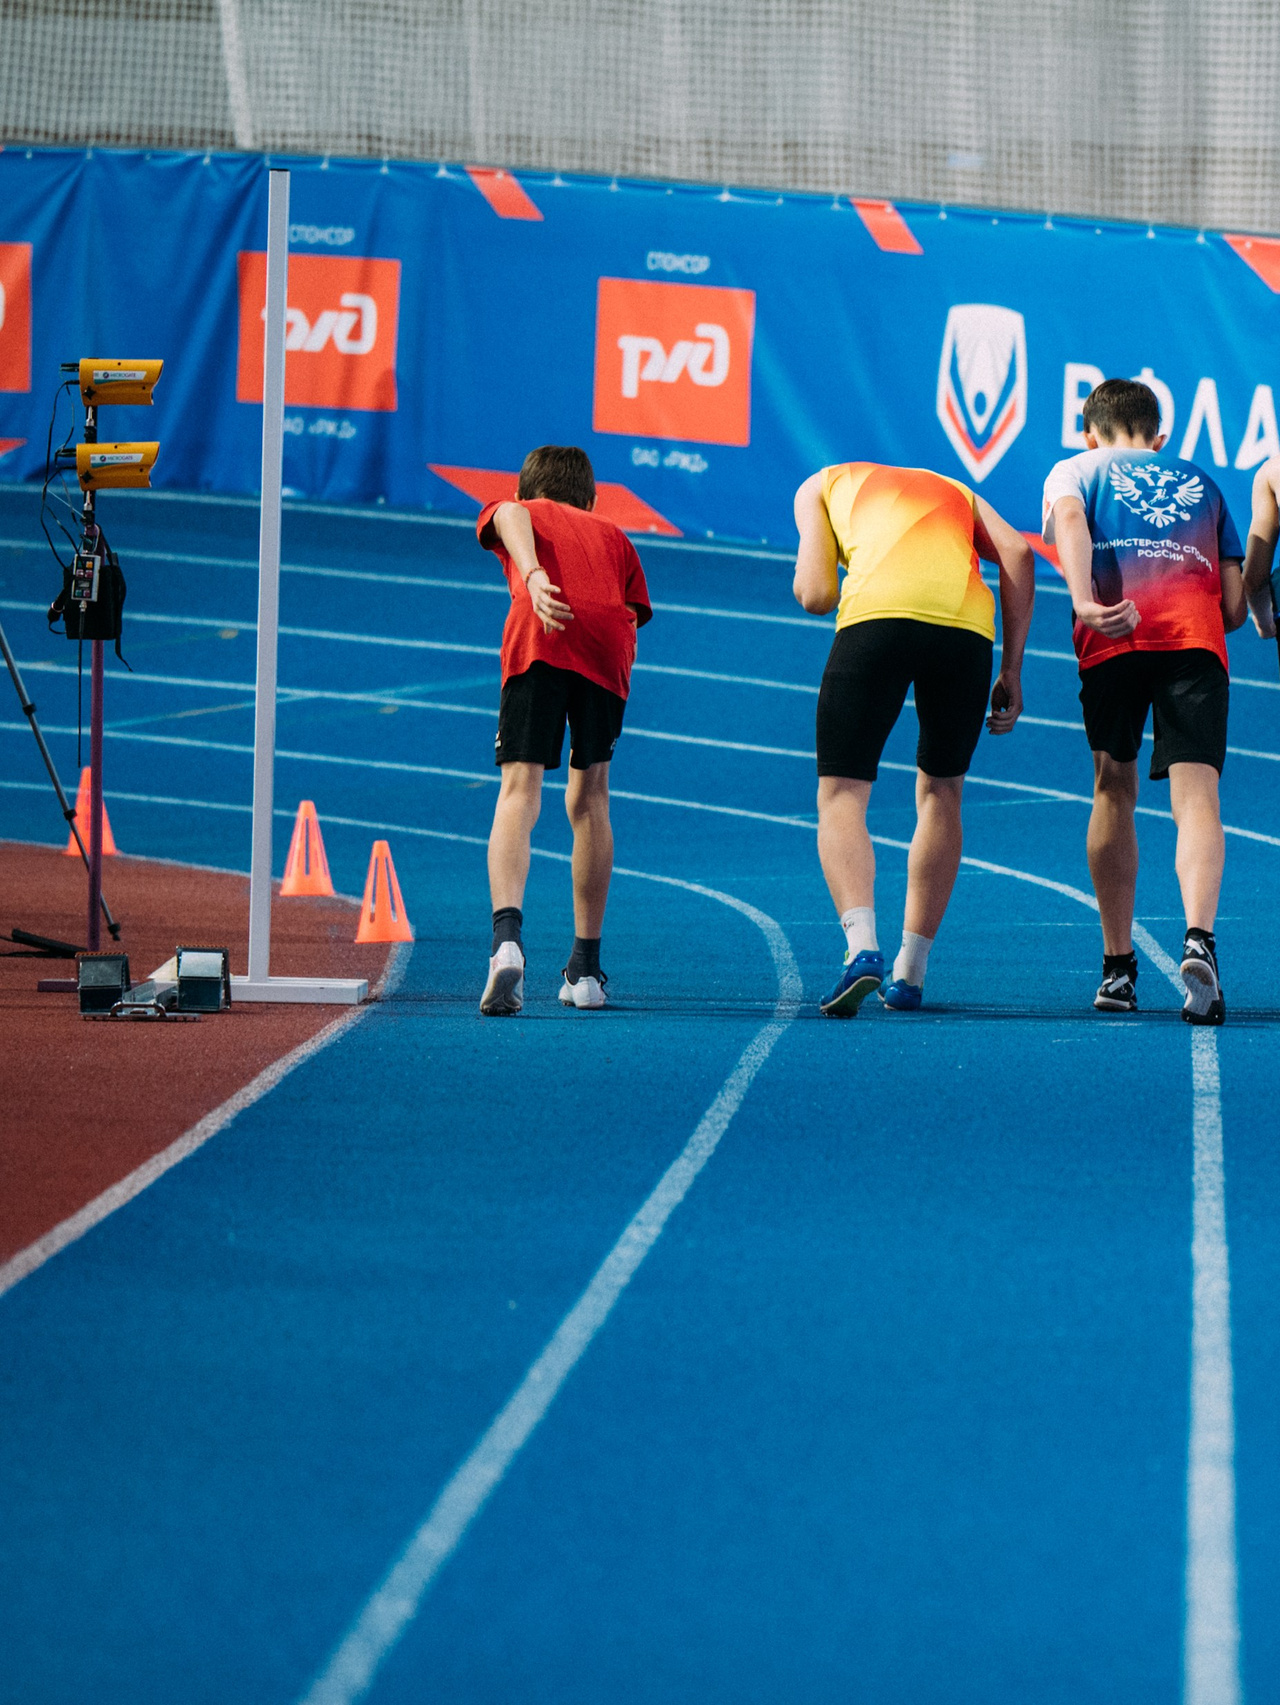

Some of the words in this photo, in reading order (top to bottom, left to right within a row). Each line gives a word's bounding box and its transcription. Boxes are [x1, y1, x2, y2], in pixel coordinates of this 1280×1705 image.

[647, 251, 711, 274] СПОНСОР
[631, 447, 659, 467] ОАО
[1092, 537, 1180, 551] МИНИСТЕРСТВО
[1137, 549, 1184, 562] РОССИИ
